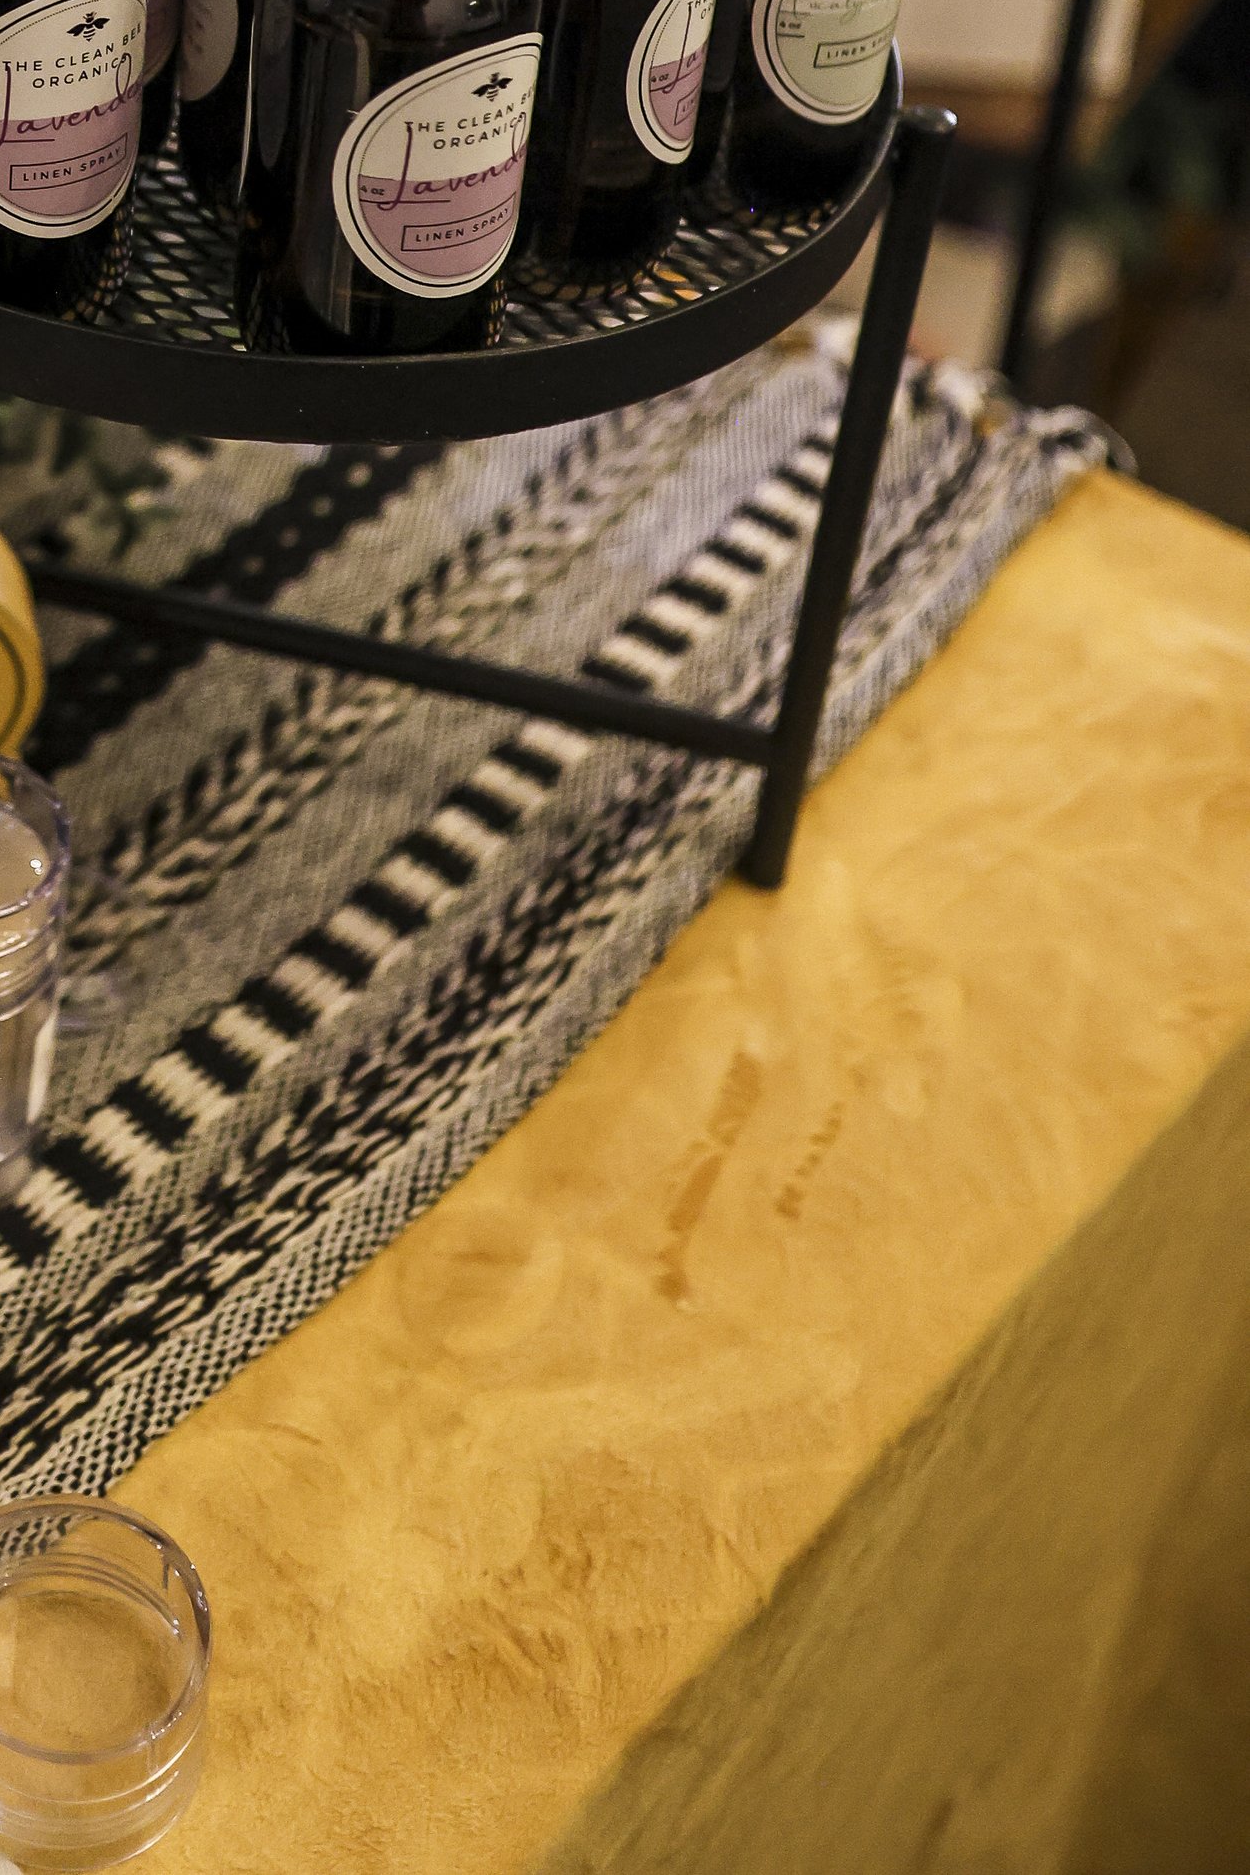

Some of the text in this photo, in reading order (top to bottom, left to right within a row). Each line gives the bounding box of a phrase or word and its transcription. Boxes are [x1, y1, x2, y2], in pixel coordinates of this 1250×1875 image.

[2, 22, 142, 72] THE CLEAN BEE
[827, 45, 866, 59] LINEN
[32, 54, 128, 89] ORGANICS
[405, 121, 445, 133] THE
[457, 102, 515, 130] CLEAN
[23, 148, 121, 182] LINEN SPRAY
[415, 227, 465, 243] LINEN
